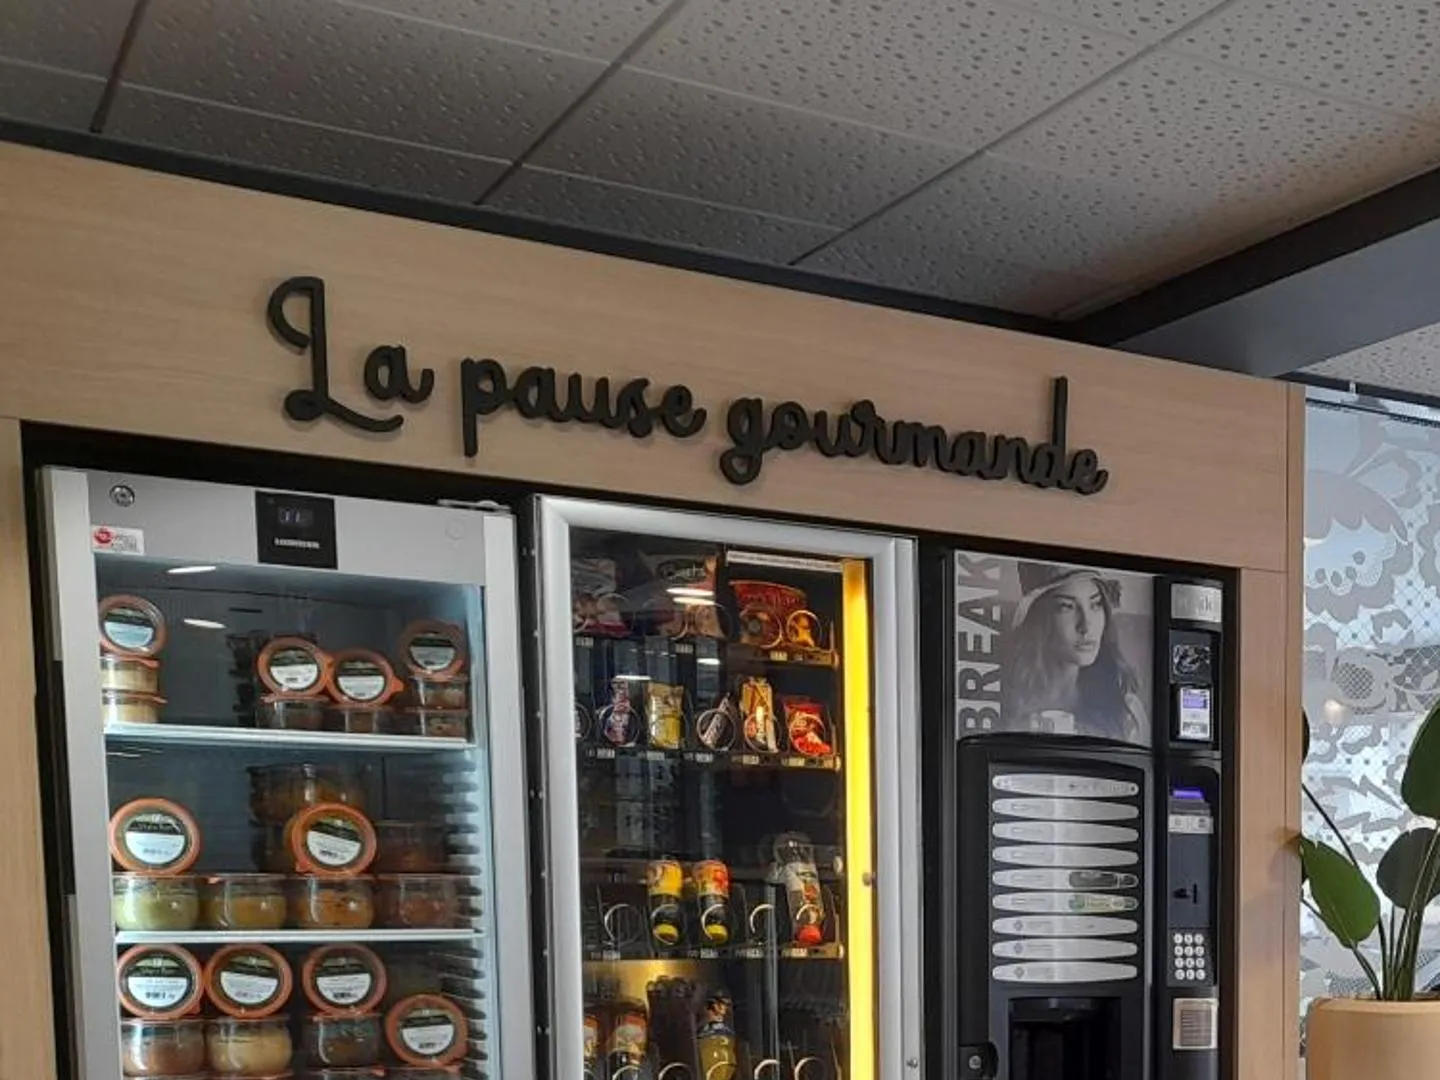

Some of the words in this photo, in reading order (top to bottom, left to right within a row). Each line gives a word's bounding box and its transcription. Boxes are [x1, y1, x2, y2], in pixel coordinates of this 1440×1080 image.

[266, 276, 436, 434] La
[461, 357, 707, 458] pause
[718, 375, 1110, 496] gourmande
[957, 553, 1002, 736] BREAK
